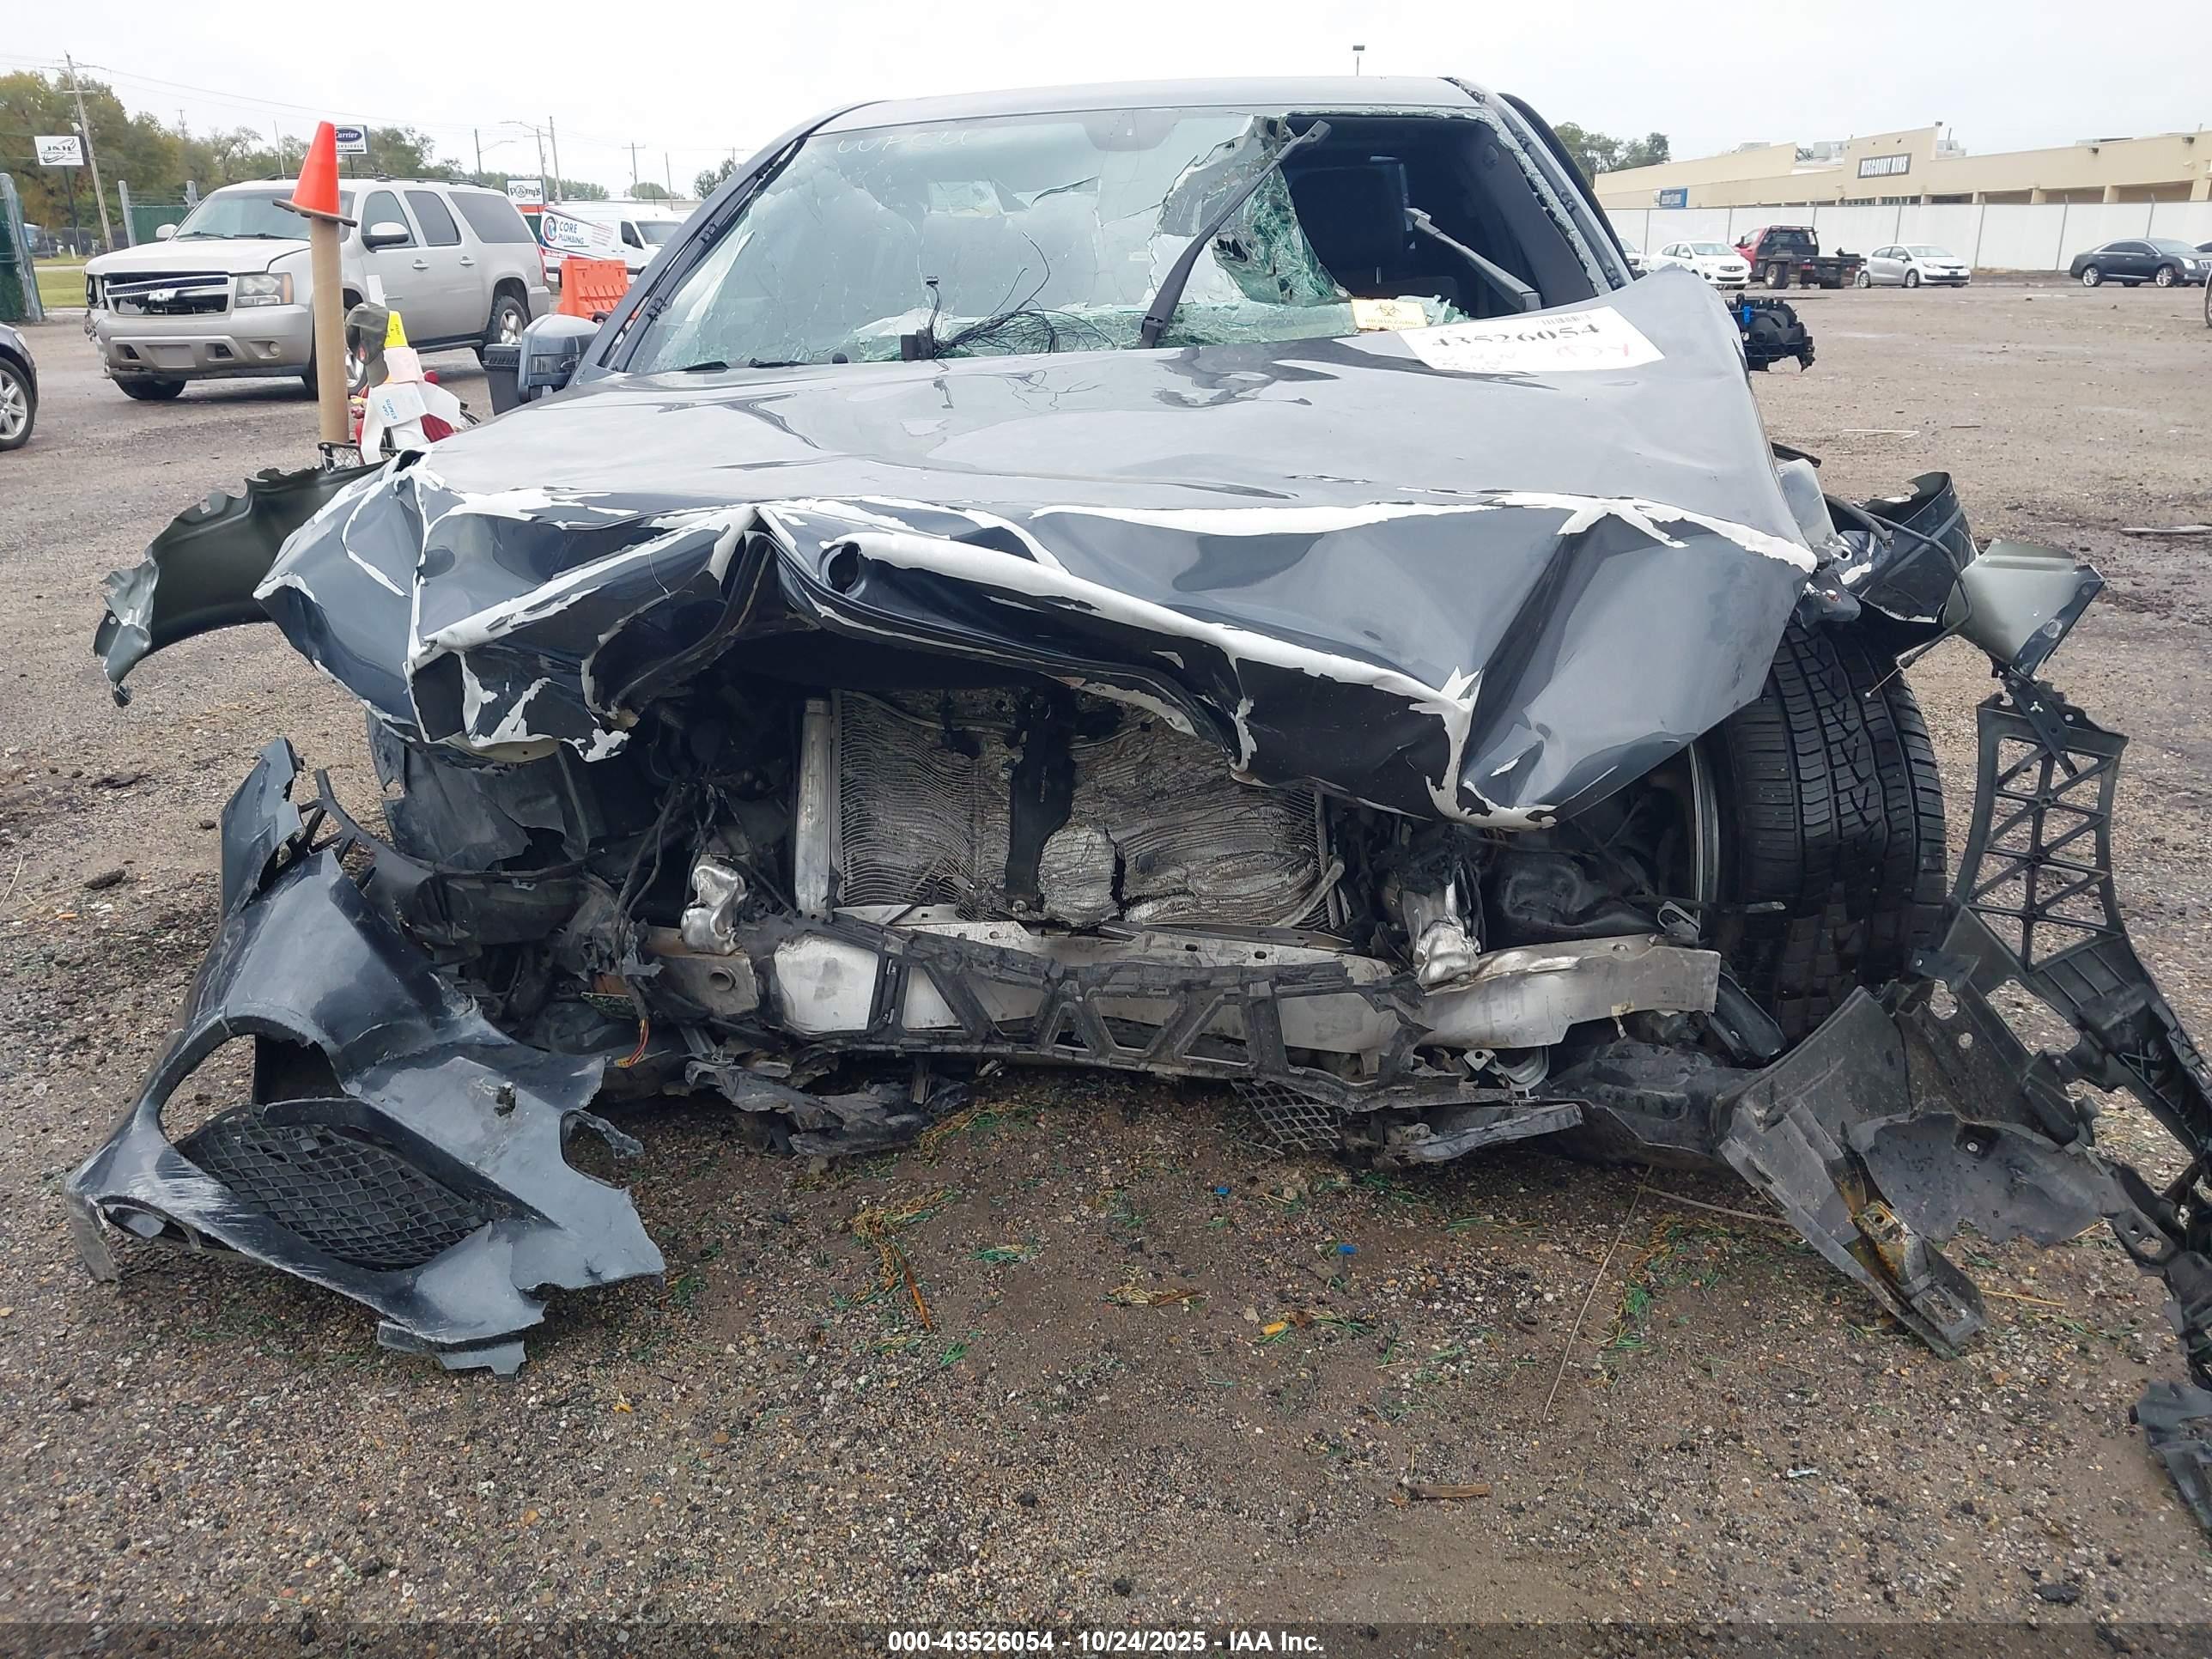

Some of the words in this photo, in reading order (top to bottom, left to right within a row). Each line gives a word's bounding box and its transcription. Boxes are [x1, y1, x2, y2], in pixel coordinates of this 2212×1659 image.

[559, 222, 577, 234] CORE
[558, 233, 584, 245] PLUMBING
[1432, 323, 1601, 347] 43526054
